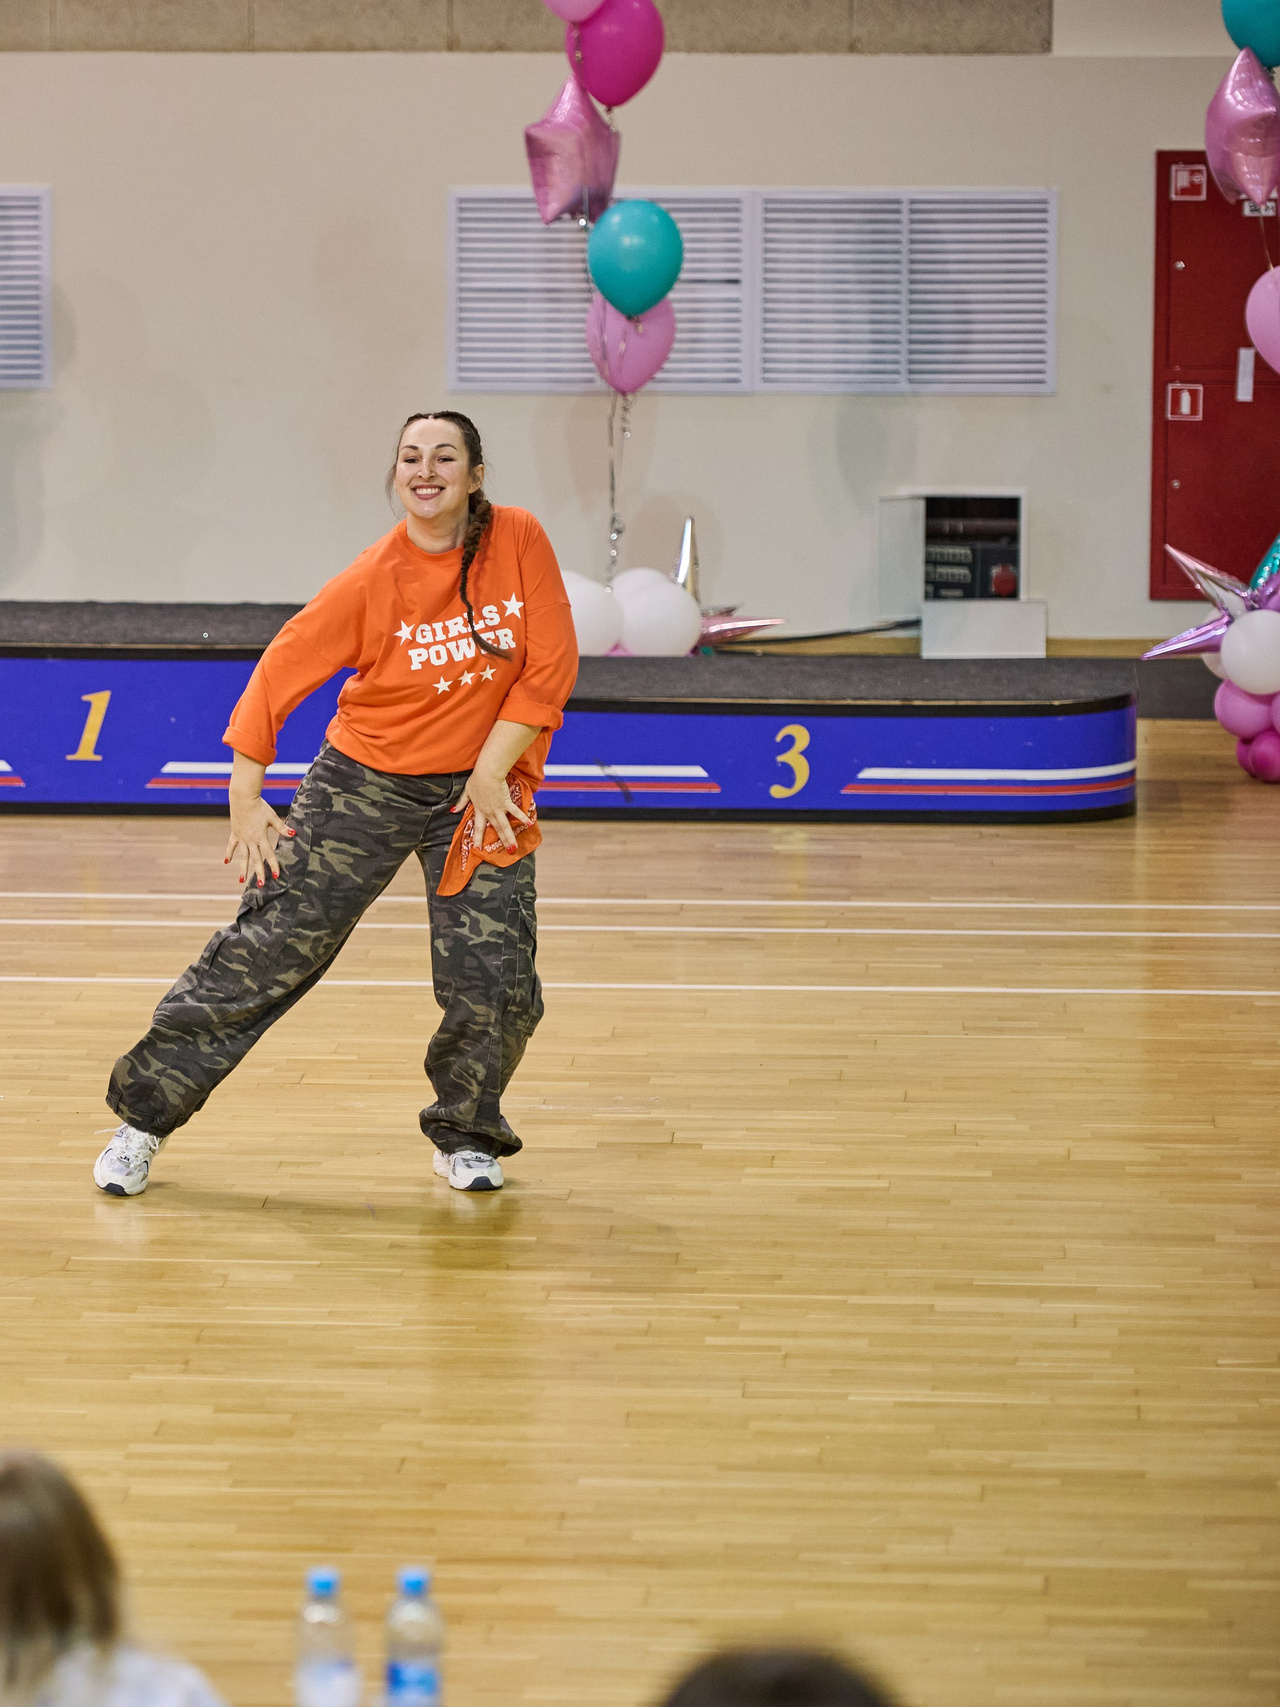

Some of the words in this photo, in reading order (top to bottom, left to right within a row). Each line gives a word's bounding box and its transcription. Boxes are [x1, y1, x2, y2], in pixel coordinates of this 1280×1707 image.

[407, 627, 517, 671] POWER
[415, 604, 501, 645] GIRLS
[65, 689, 112, 761] 1
[769, 723, 811, 799] 3
